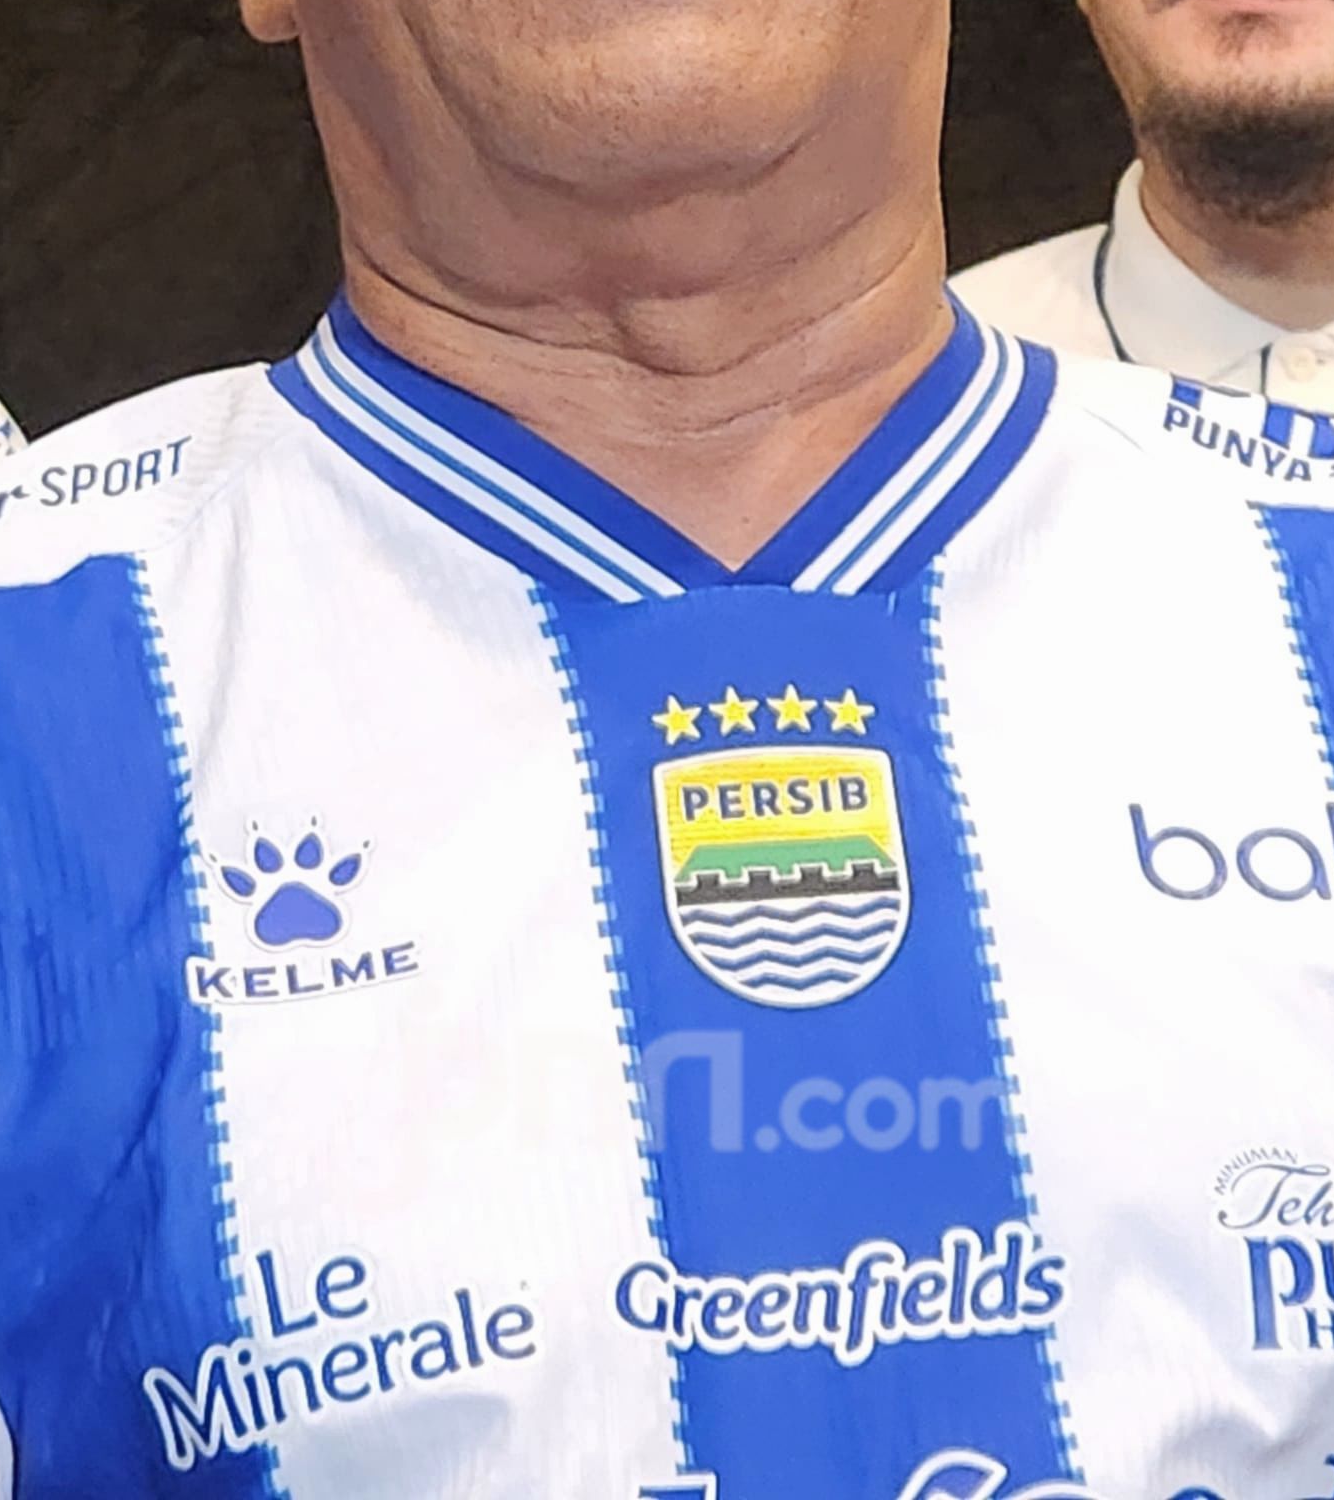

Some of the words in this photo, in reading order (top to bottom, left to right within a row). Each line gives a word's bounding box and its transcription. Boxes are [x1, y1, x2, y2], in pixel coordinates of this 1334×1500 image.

[40, 435, 193, 508] SPORT
[1163, 402, 1312, 482] PUNYA
[681, 776, 869, 822] PERSIB
[195, 940, 420, 999] KELME
[1214, 1146, 1299, 1196] MINUMAN
[255, 1247, 373, 1337] Le
[615, 1227, 1067, 1358] Greenfields
[152, 1289, 537, 1457] Minerale
